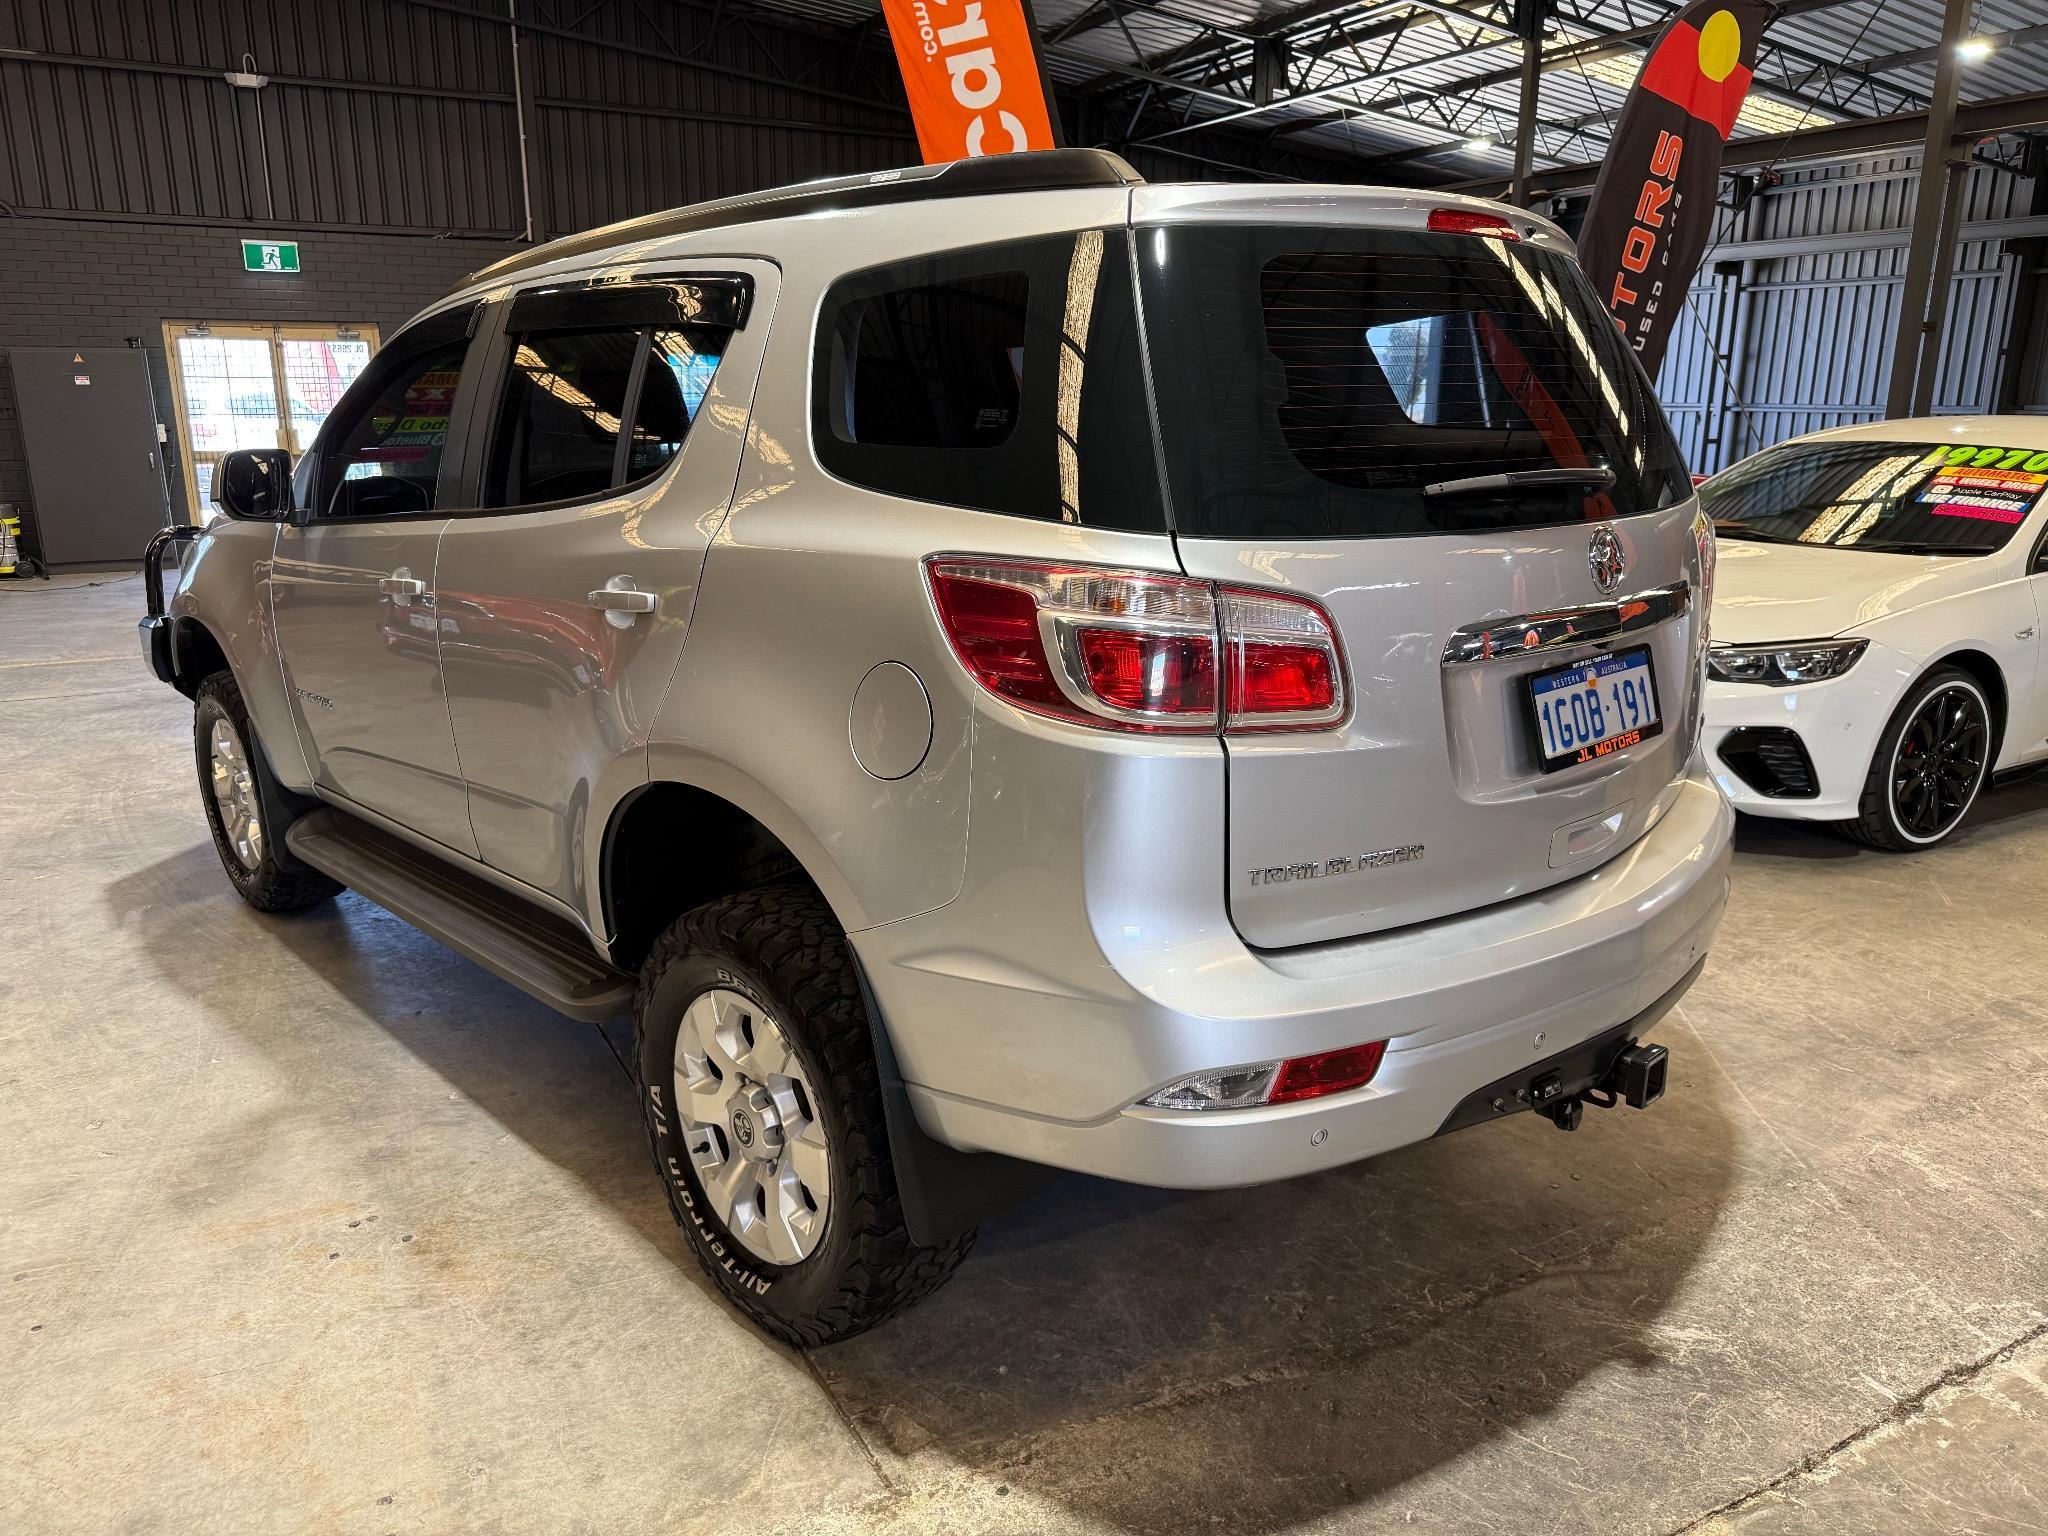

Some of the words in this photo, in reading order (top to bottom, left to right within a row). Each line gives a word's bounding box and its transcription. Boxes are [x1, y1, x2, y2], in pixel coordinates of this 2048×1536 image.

[1611, 129, 1683, 334] TORS
[1632, 280, 1664, 352] USED
[1952, 467, 2035, 480] AUTOMATIC
[1959, 477, 2000, 487] WHEEL
[2000, 480, 2044, 492] DRIVE
[1948, 495, 2026, 511] FINANCE
[1952, 486, 1982, 496] Apple
[1984, 489, 2022, 500] CarPlay
[1936, 505, 1977, 516] Service
[1978, 509, 2017, 520] History
[1552, 674, 1580, 689] WESTERN
[1601, 661, 1628, 675] AUSTRALIA
[1577, 746, 1593, 763] JL
[1594, 730, 1640, 758] MOTORS
[1248, 844, 1425, 887] TRAILBLAZER
[650, 1085, 670, 1138] T/A
[668, 1156, 772, 1296] All-Terrain
